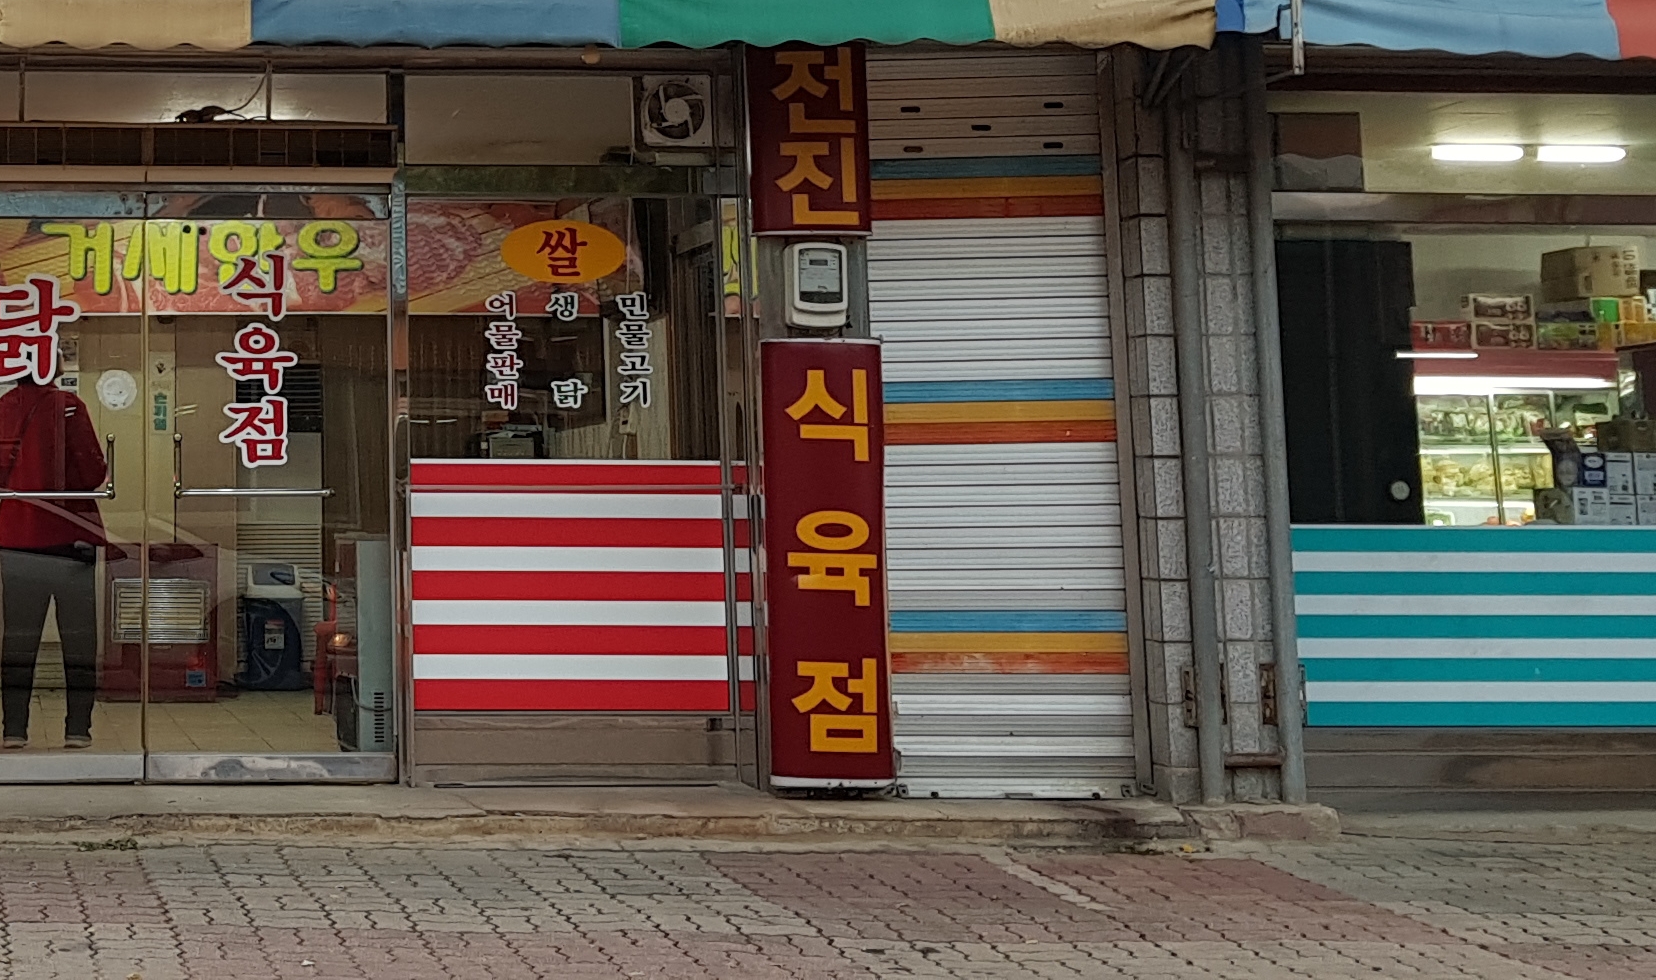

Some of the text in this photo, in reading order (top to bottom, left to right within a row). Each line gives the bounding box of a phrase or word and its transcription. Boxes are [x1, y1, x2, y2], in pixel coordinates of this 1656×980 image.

[536, 226, 588, 278] 쌀
[215, 250, 299, 470] 식육점
[615, 291, 654, 409] 민물고기
